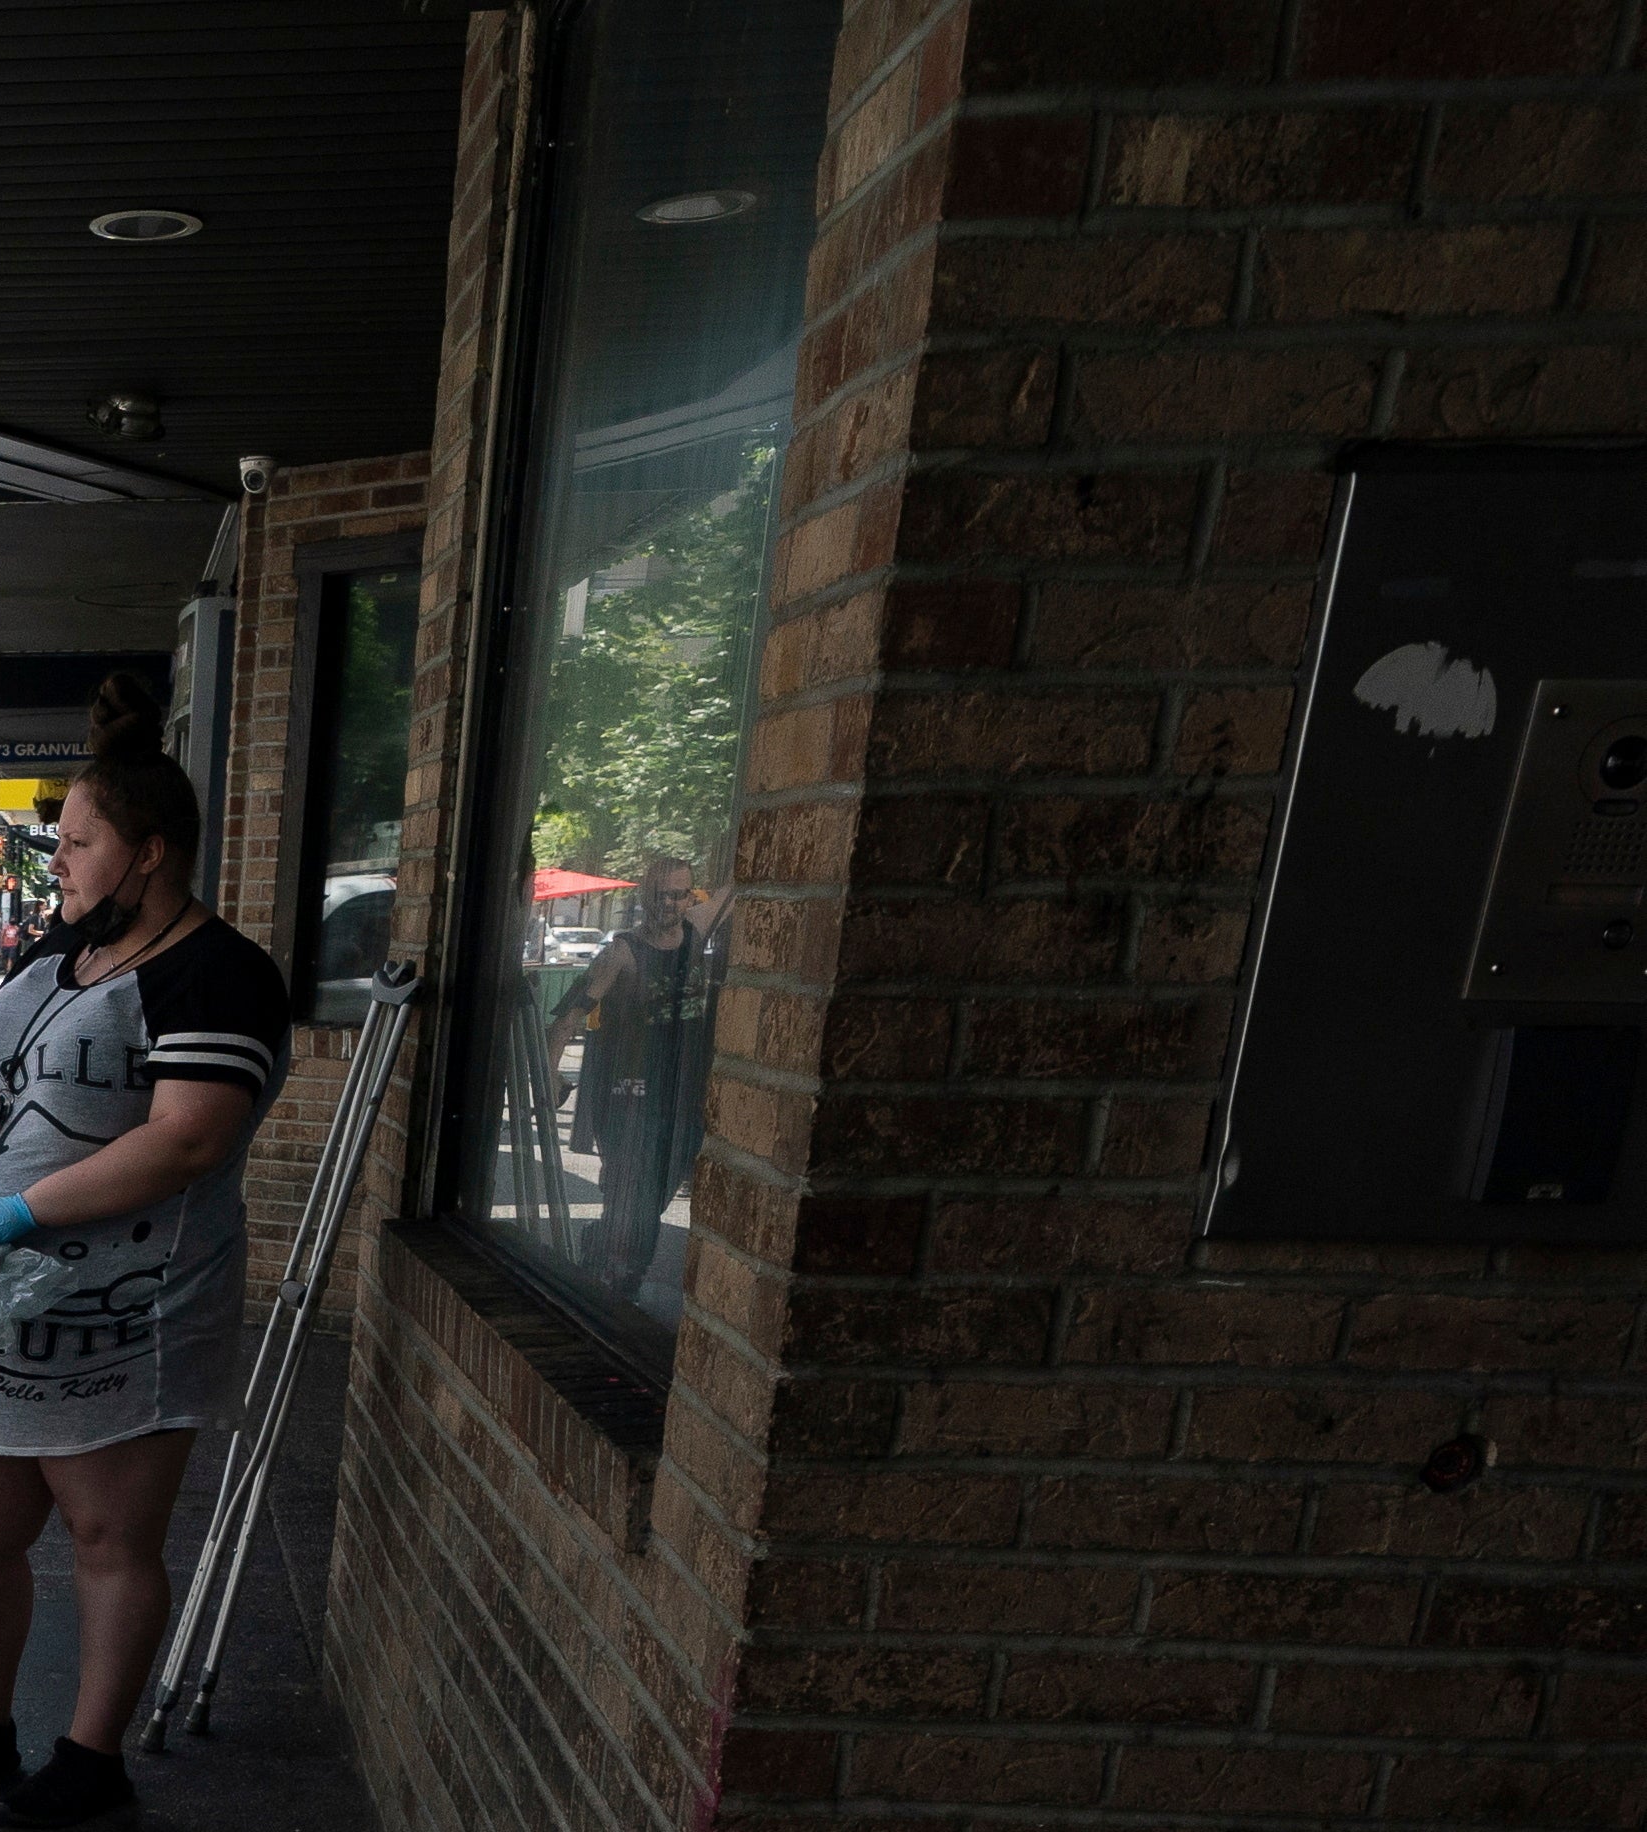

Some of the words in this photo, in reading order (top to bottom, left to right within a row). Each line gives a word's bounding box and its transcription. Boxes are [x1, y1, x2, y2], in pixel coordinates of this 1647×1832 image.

[14, 743, 94, 756] GRANVILL
[29, 825, 59, 836] BLE
[59, 1372, 129, 1401] Kitty
